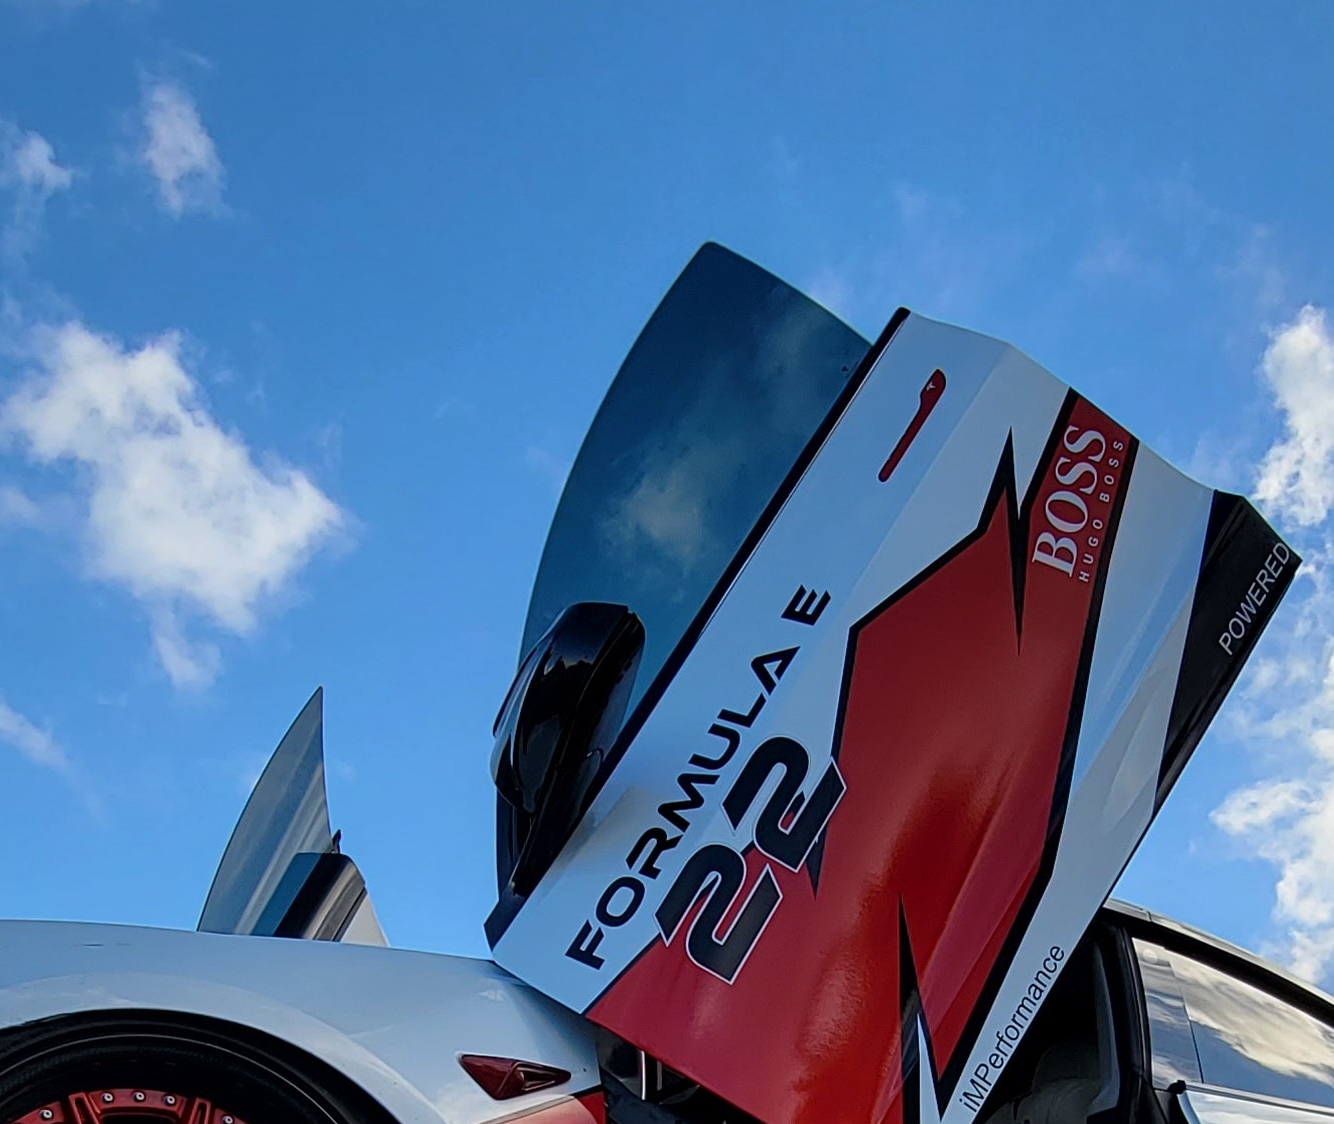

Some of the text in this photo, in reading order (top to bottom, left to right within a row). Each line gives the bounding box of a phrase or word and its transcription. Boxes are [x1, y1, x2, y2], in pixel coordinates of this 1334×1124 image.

[1032, 425, 1106, 577] BOSS
[1078, 440, 1124, 583] HUGO BOSS
[1218, 542, 1290, 656] POWERED
[564, 584, 831, 970] FORMULA E
[654, 736, 847, 985] 22
[959, 945, 1065, 1113] iMPerformance
